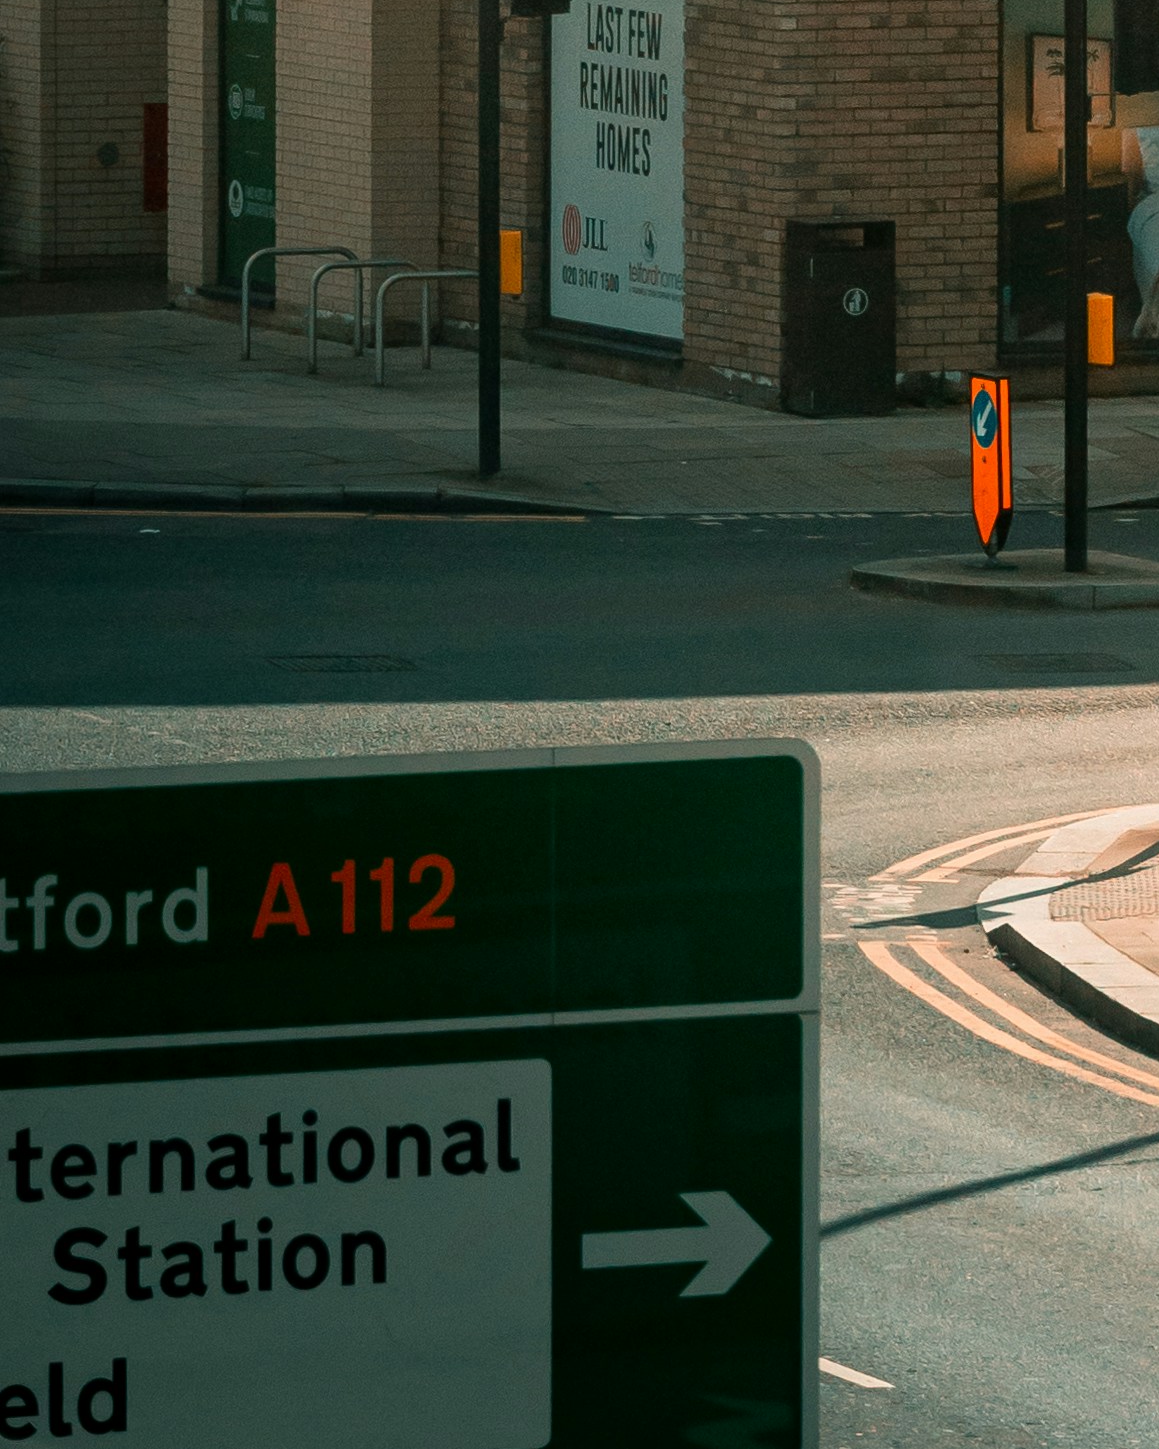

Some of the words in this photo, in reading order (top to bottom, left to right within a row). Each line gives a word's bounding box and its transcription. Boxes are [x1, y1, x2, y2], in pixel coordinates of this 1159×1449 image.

[587, 3, 623, 54] LAST
[628, 9, 662, 60] FEW
[580, 61, 668, 121] REMAINING
[596, 121, 651, 176] HOMES
[583, 216, 609, 251] JLL
[562, 265, 578, 285] 020
[578, 267, 599, 289] 3147
[600, 272, 619, 293] 1500
[8, 1098, 521, 1203] ternational
[47, 1216, 387, 1306] Station
